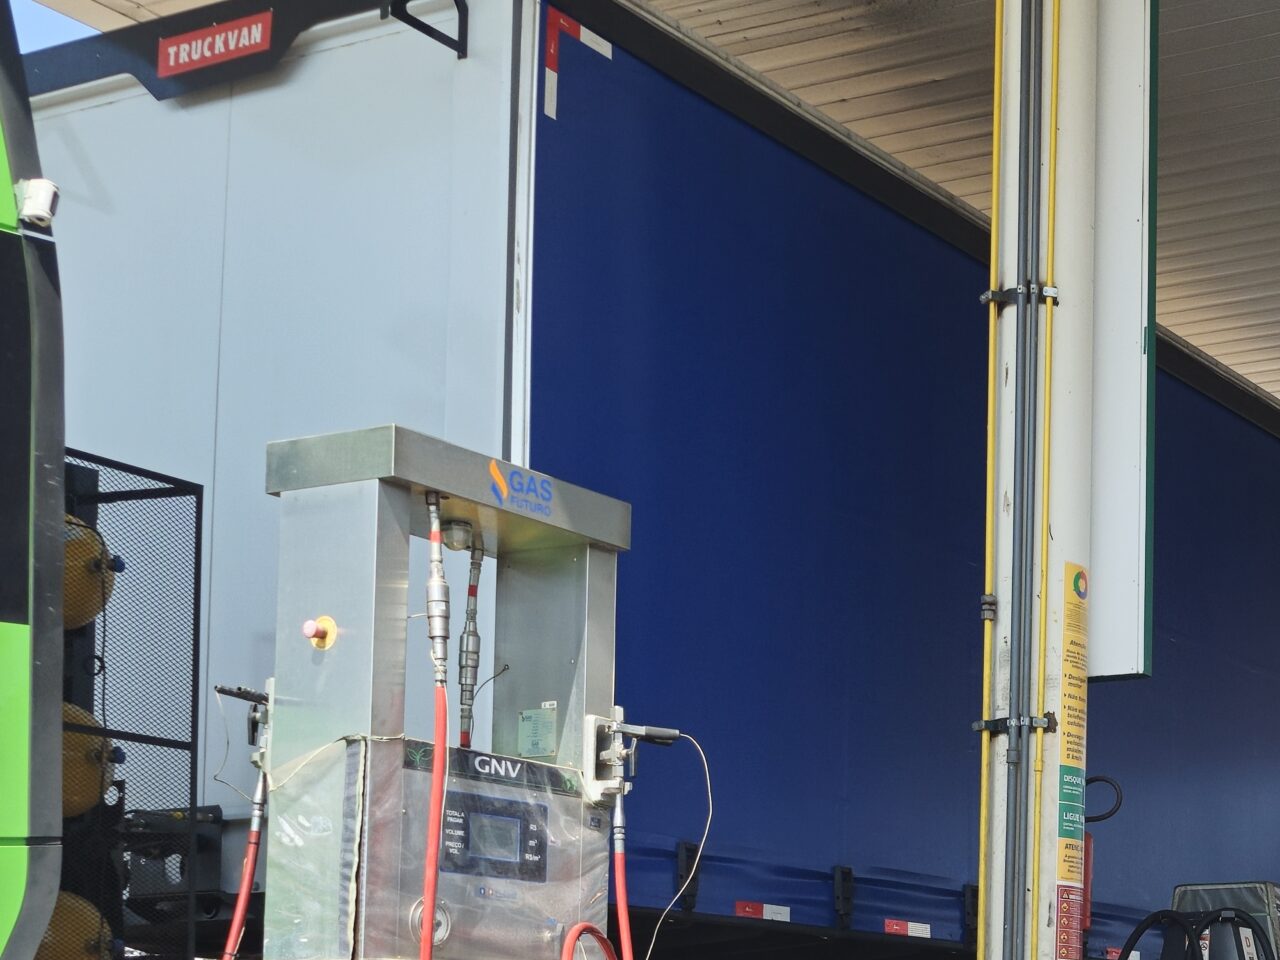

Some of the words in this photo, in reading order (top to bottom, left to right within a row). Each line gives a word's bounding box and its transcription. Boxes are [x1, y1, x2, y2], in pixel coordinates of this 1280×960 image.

[167, 23, 262, 66] TRUCKVAN
[509, 470, 553, 501] GAS
[510, 495, 552, 517] FUTURO
[474, 755, 521, 778] GNV
